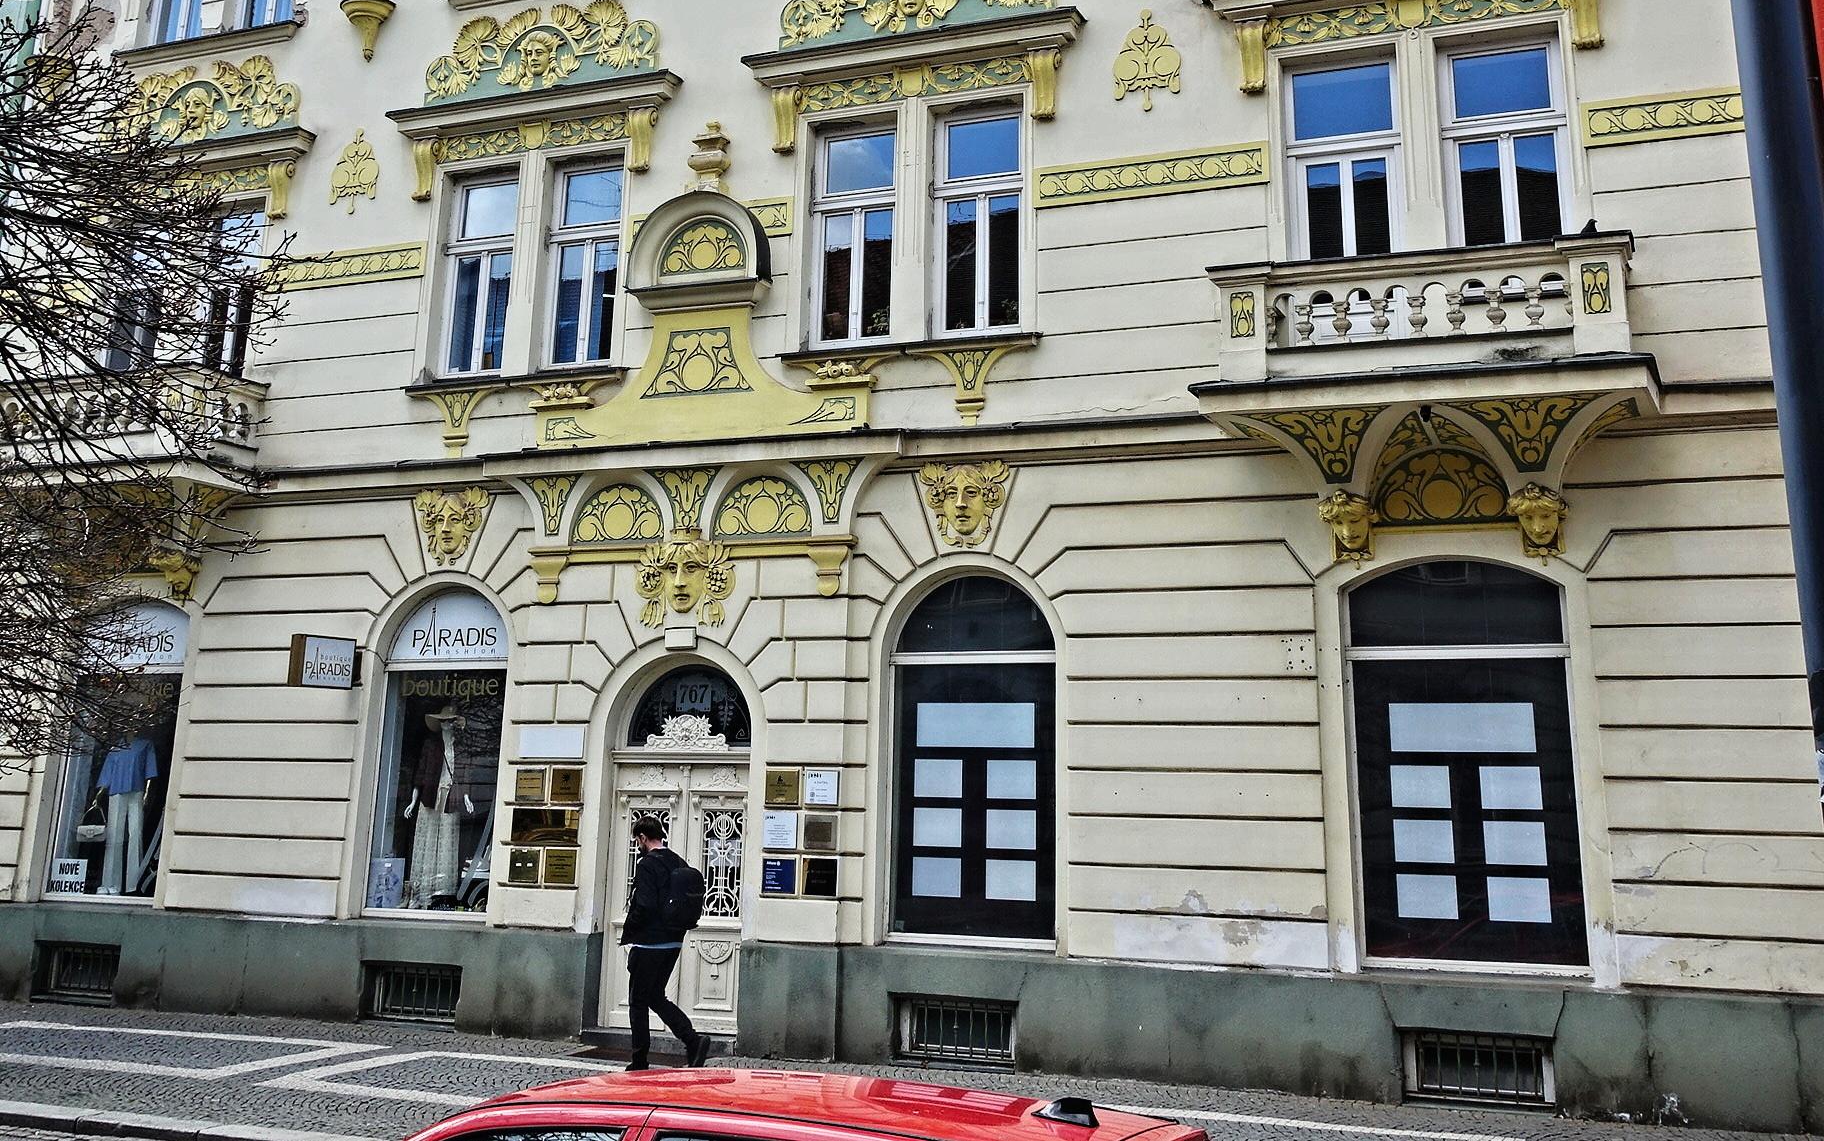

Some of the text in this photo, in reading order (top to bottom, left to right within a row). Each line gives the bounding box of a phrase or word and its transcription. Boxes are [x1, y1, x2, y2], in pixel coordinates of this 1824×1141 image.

[412, 601, 497, 656] PARADIS
[305, 647, 351, 680] PARADIS
[400, 672, 499, 702] boutique
[680, 684, 709, 704] 767
[59, 861, 80, 875] NOVÉ
[50, 880, 84, 893] KOLEKCE
